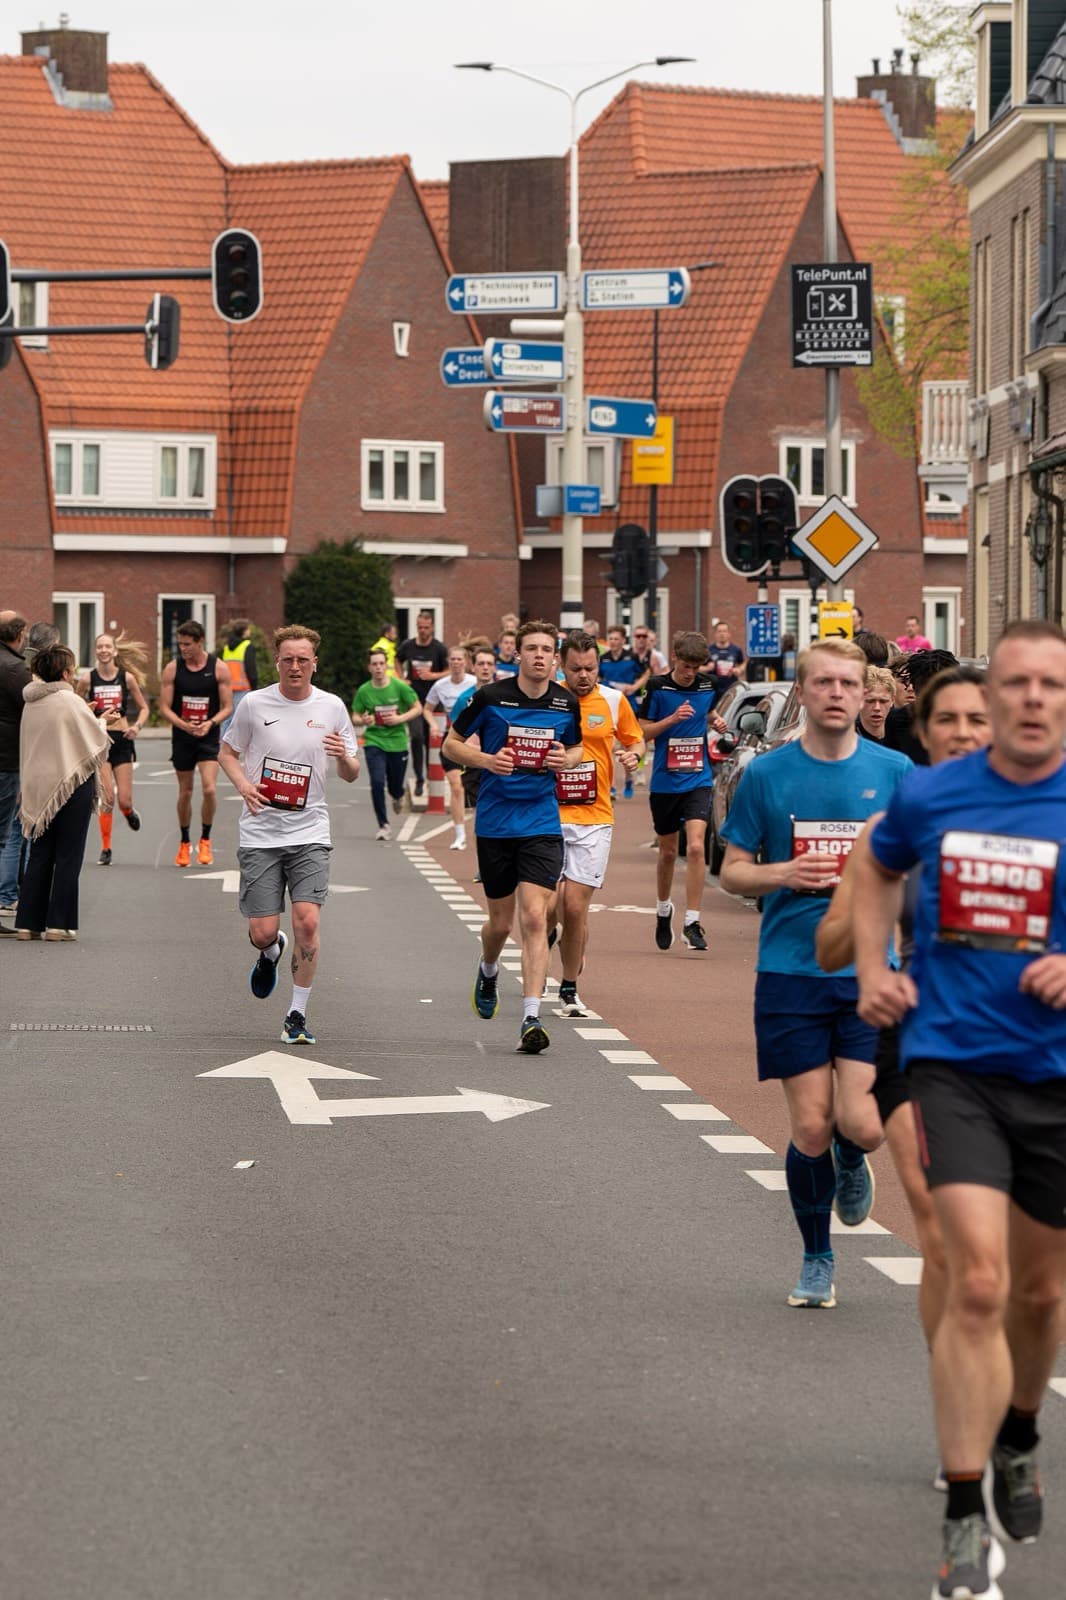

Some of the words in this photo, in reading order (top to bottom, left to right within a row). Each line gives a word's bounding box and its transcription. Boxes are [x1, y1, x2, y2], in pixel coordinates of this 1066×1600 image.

[796, 267, 867, 281] TelePunt.nl
[480, 281, 529, 290] Technology
[589, 278, 627, 287] Centrum
[601, 292, 635, 300] Station
[802, 322, 863, 330] TELECOM
[795, 331, 869, 340] REPARATIE
[804, 341, 861, 349] SERVICE
[524, 728, 546, 736] ROSEN
[515, 738, 549, 749] 14405
[518, 750, 541, 758] OSCAR
[280, 763, 302, 772] ROSEN
[270, 772, 305, 786] 15684
[560, 772, 592, 782] 12345
[274, 793, 290, 801] 10KM
[820, 823, 857, 833] ROSEN
[982, 840, 1033, 856] ROSEN
[957, 860, 1044, 892] 13908
[959, 890, 1027, 912] DENNIS
